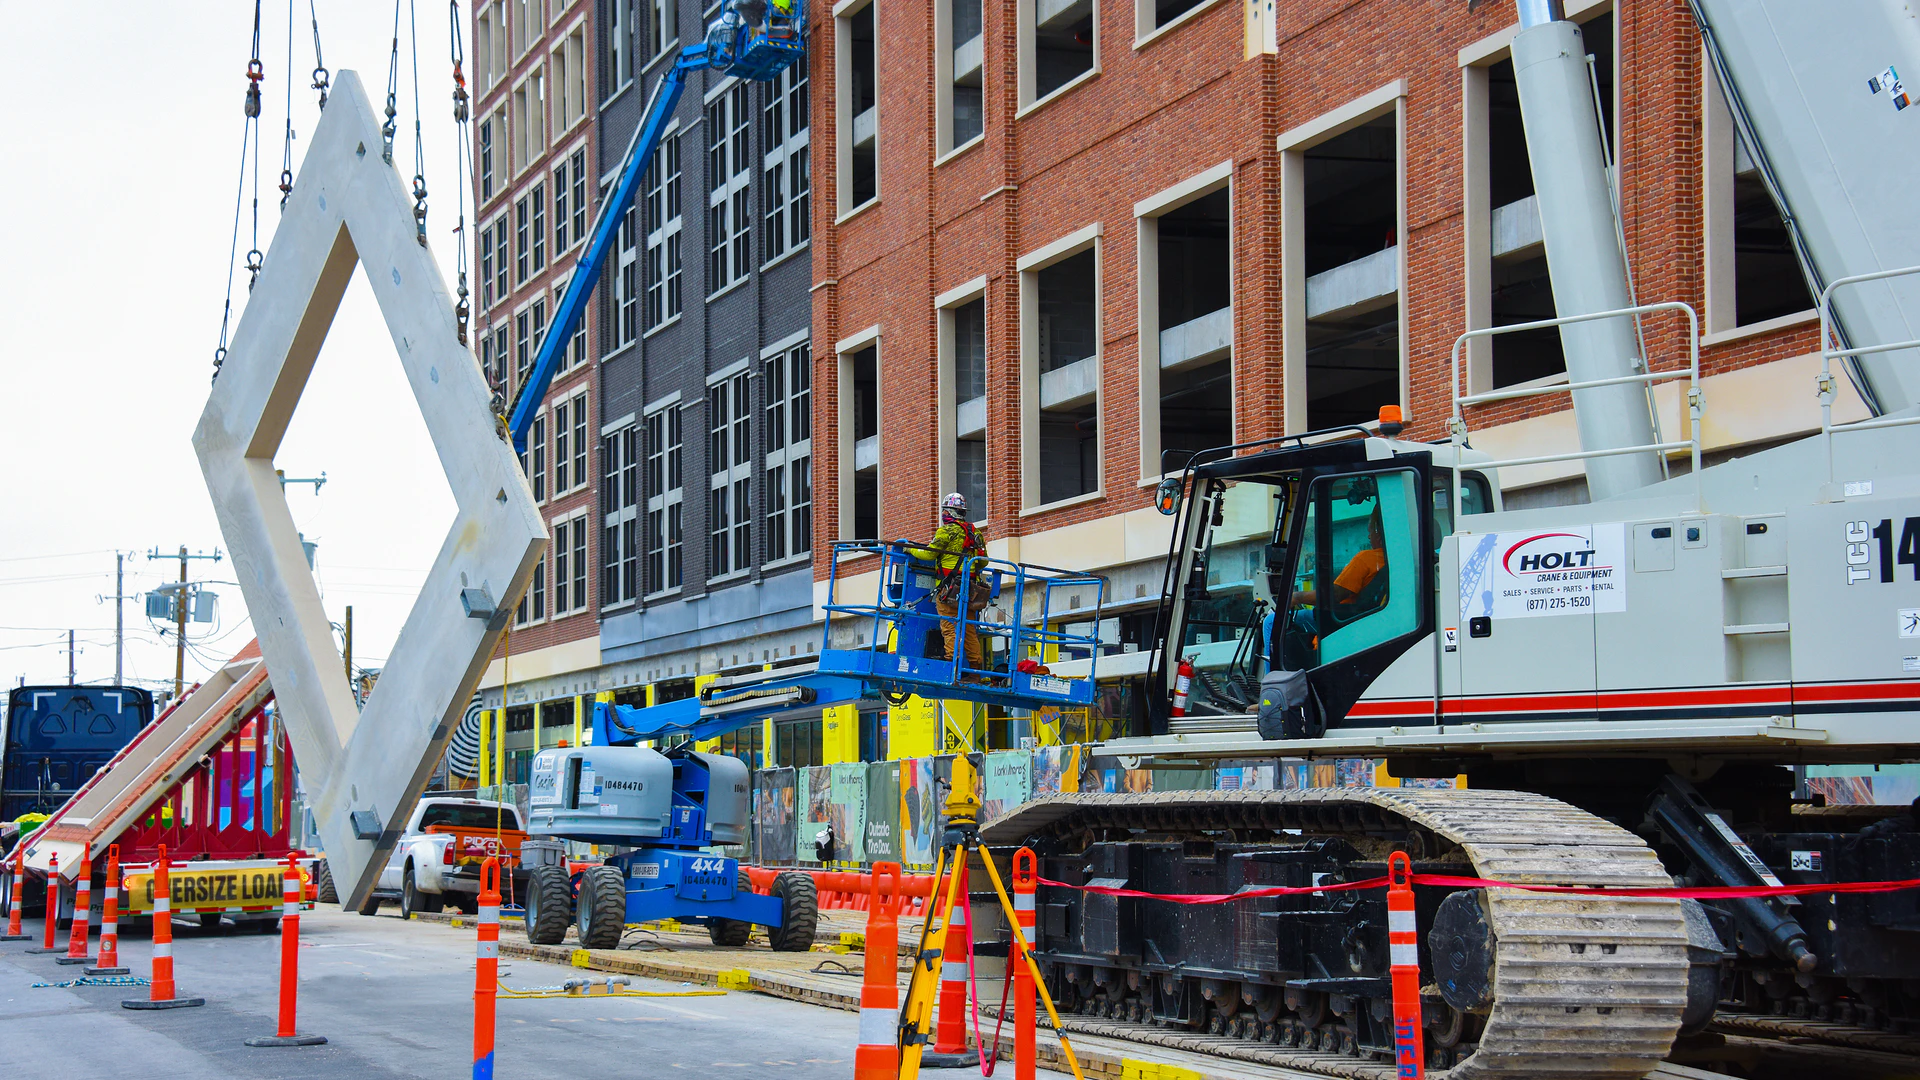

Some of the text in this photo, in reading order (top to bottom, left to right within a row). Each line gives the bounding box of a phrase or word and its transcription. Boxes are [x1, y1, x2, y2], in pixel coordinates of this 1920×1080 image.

[1520, 550, 1596, 571] HOLT
[1845, 520, 1871, 585] TCC
[1537, 569, 1613, 582] CRANE & EQUIPMENT
[1530, 587, 1555, 596] SERVICE
[1563, 585, 1582, 593] PARTS
[1591, 583, 1615, 591] RENTAL
[1526, 596, 1591, 611] (877) 275-1520
[946, 732, 955, 749] GP
[604, 780, 643, 791] 10484470
[691, 857, 725, 874] 4x4
[684, 875, 728, 886] 10484470
[146, 875, 237, 904] OERSIZE
